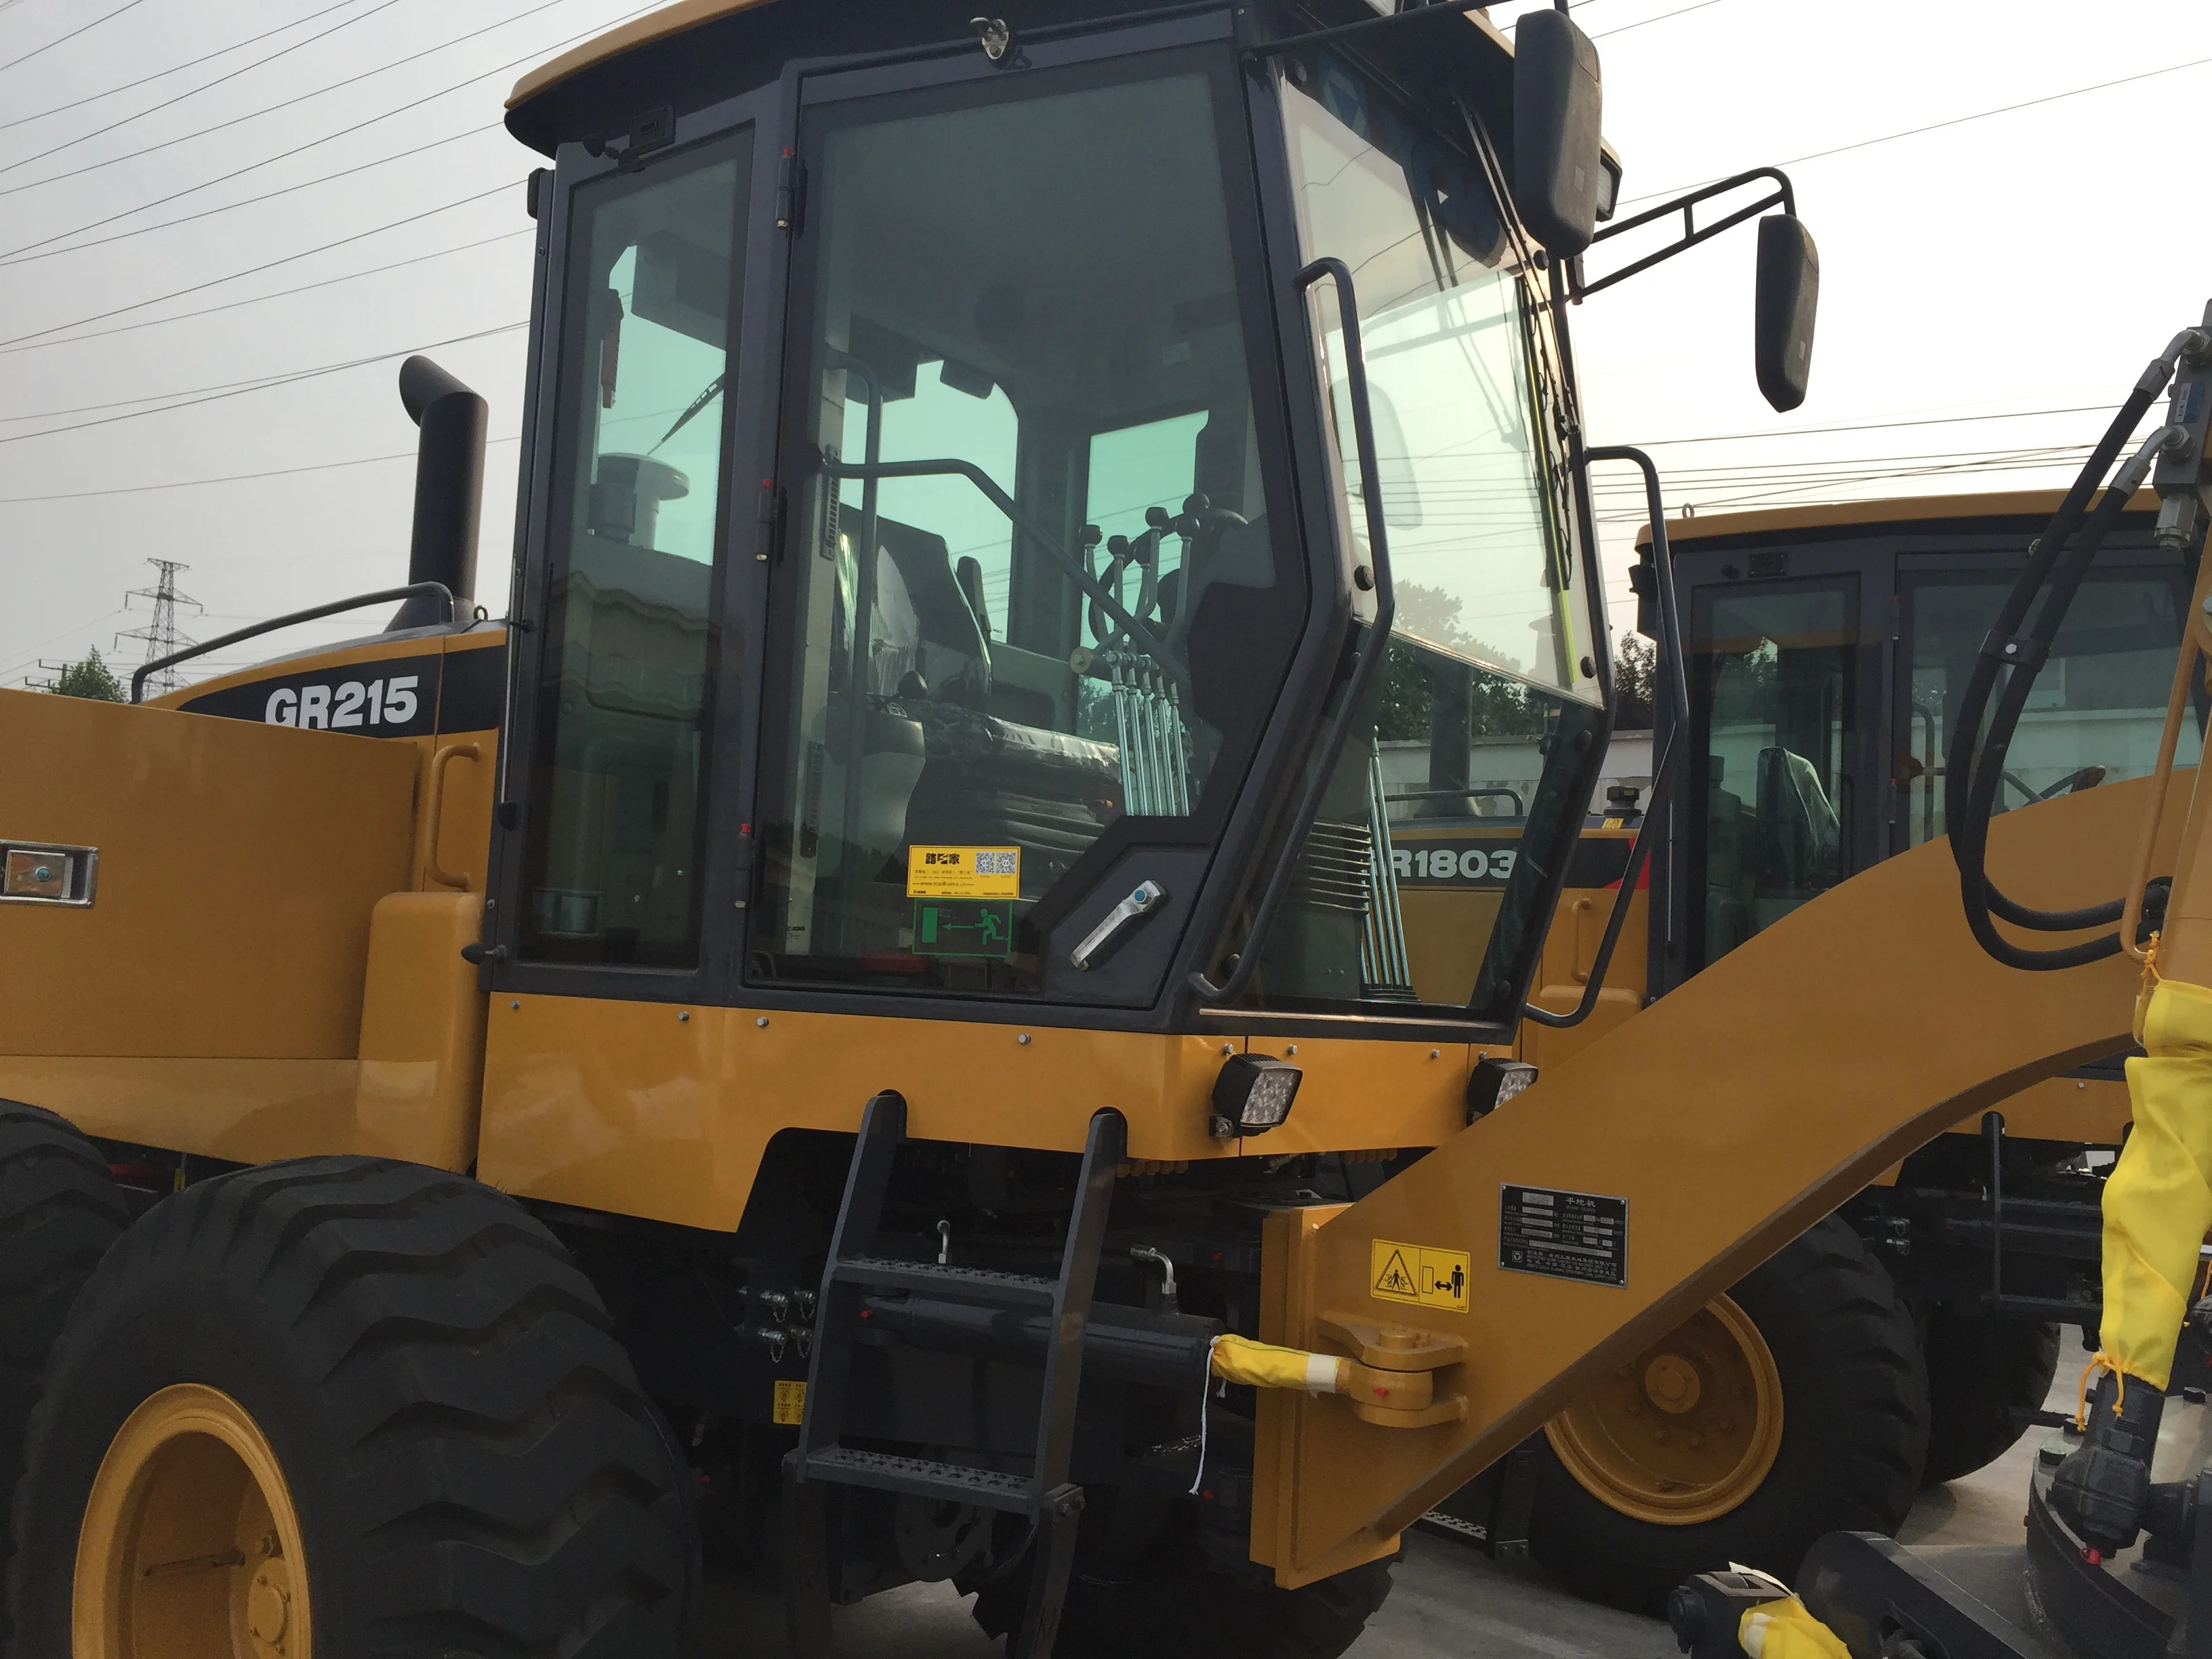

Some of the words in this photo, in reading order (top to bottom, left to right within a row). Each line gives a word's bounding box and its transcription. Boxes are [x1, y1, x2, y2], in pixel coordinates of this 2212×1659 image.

[265, 675, 419, 730] GR215
[1371, 849, 1517, 879] R1803
[1565, 1197, 1595, 1207] 平地机
